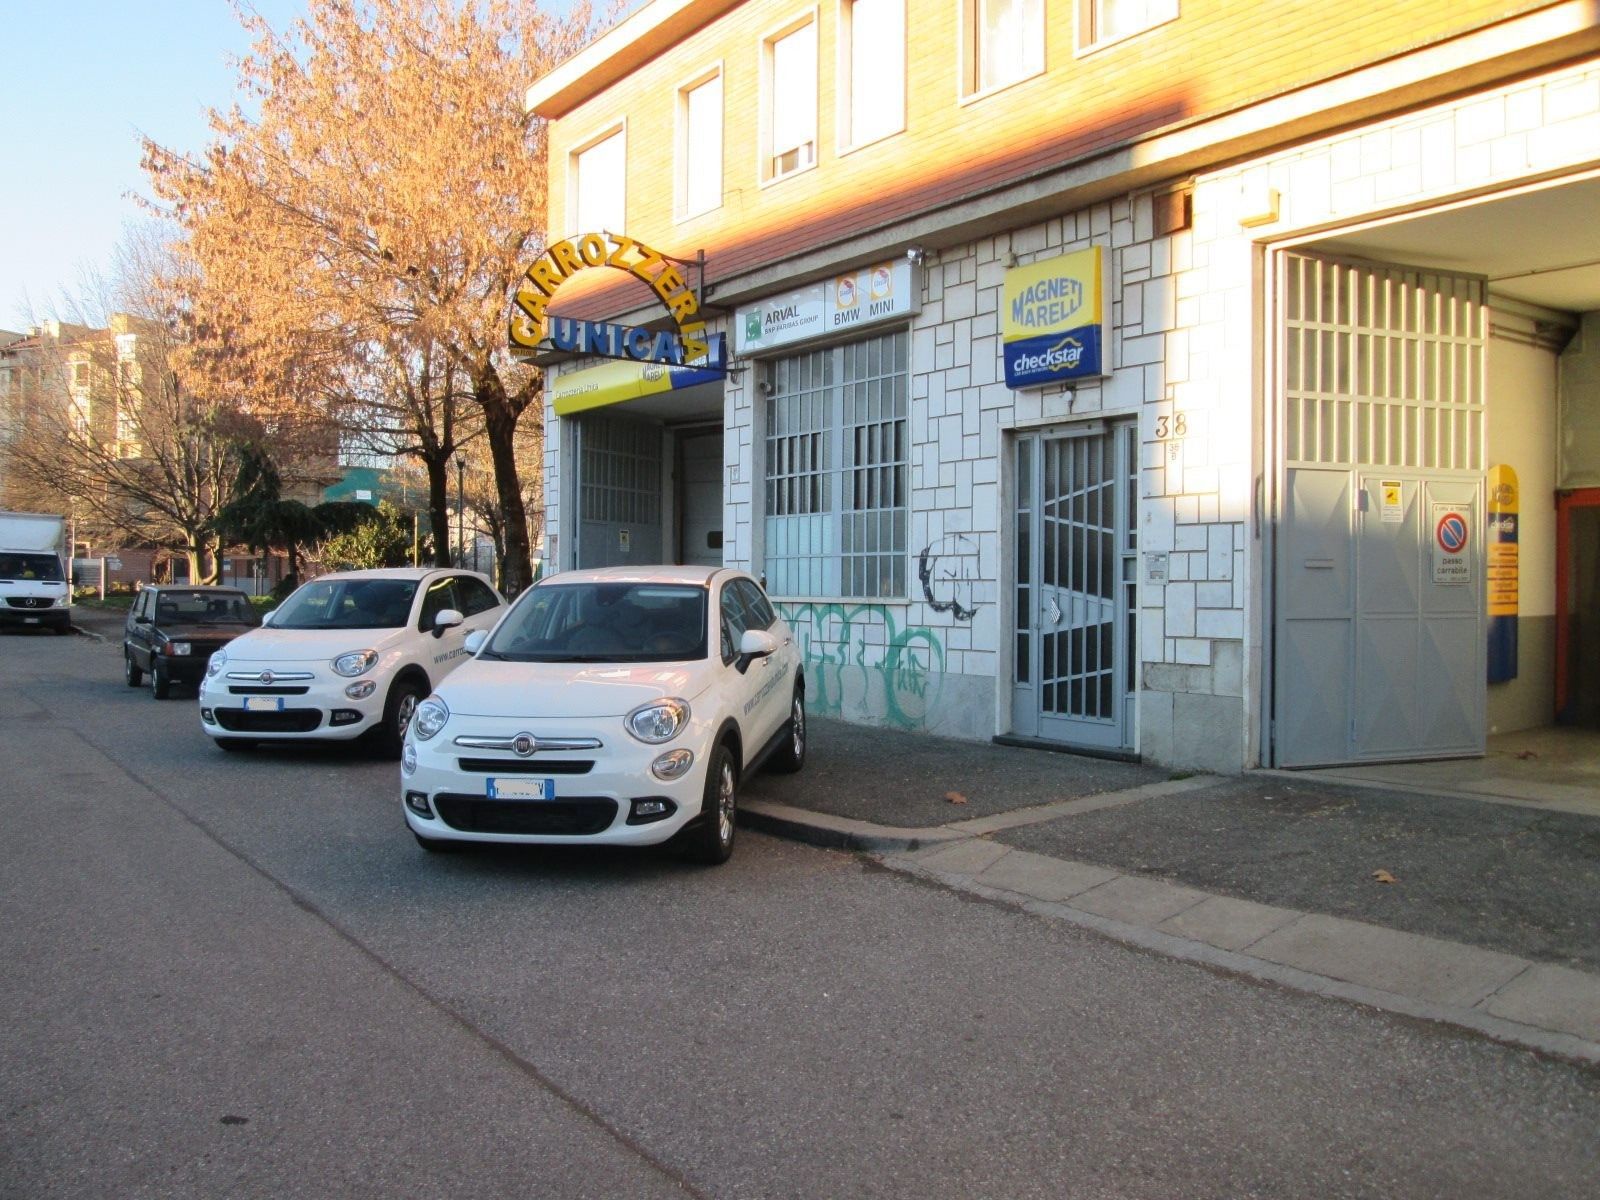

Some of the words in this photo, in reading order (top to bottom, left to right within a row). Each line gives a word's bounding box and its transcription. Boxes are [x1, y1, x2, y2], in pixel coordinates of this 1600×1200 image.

[509, 233, 709, 364] CARROZZERIA
[1012, 277, 1082, 309] MAGNETI
[765, 305, 800, 325] ARVAL
[834, 308, 860, 325] BMW
[869, 299, 894, 317] MINI
[1012, 299, 1082, 327] MARELLI
[550, 315, 678, 364] UNICA
[1014, 347, 1083, 371] checkstar
[1155, 413, 1187, 438] 38
